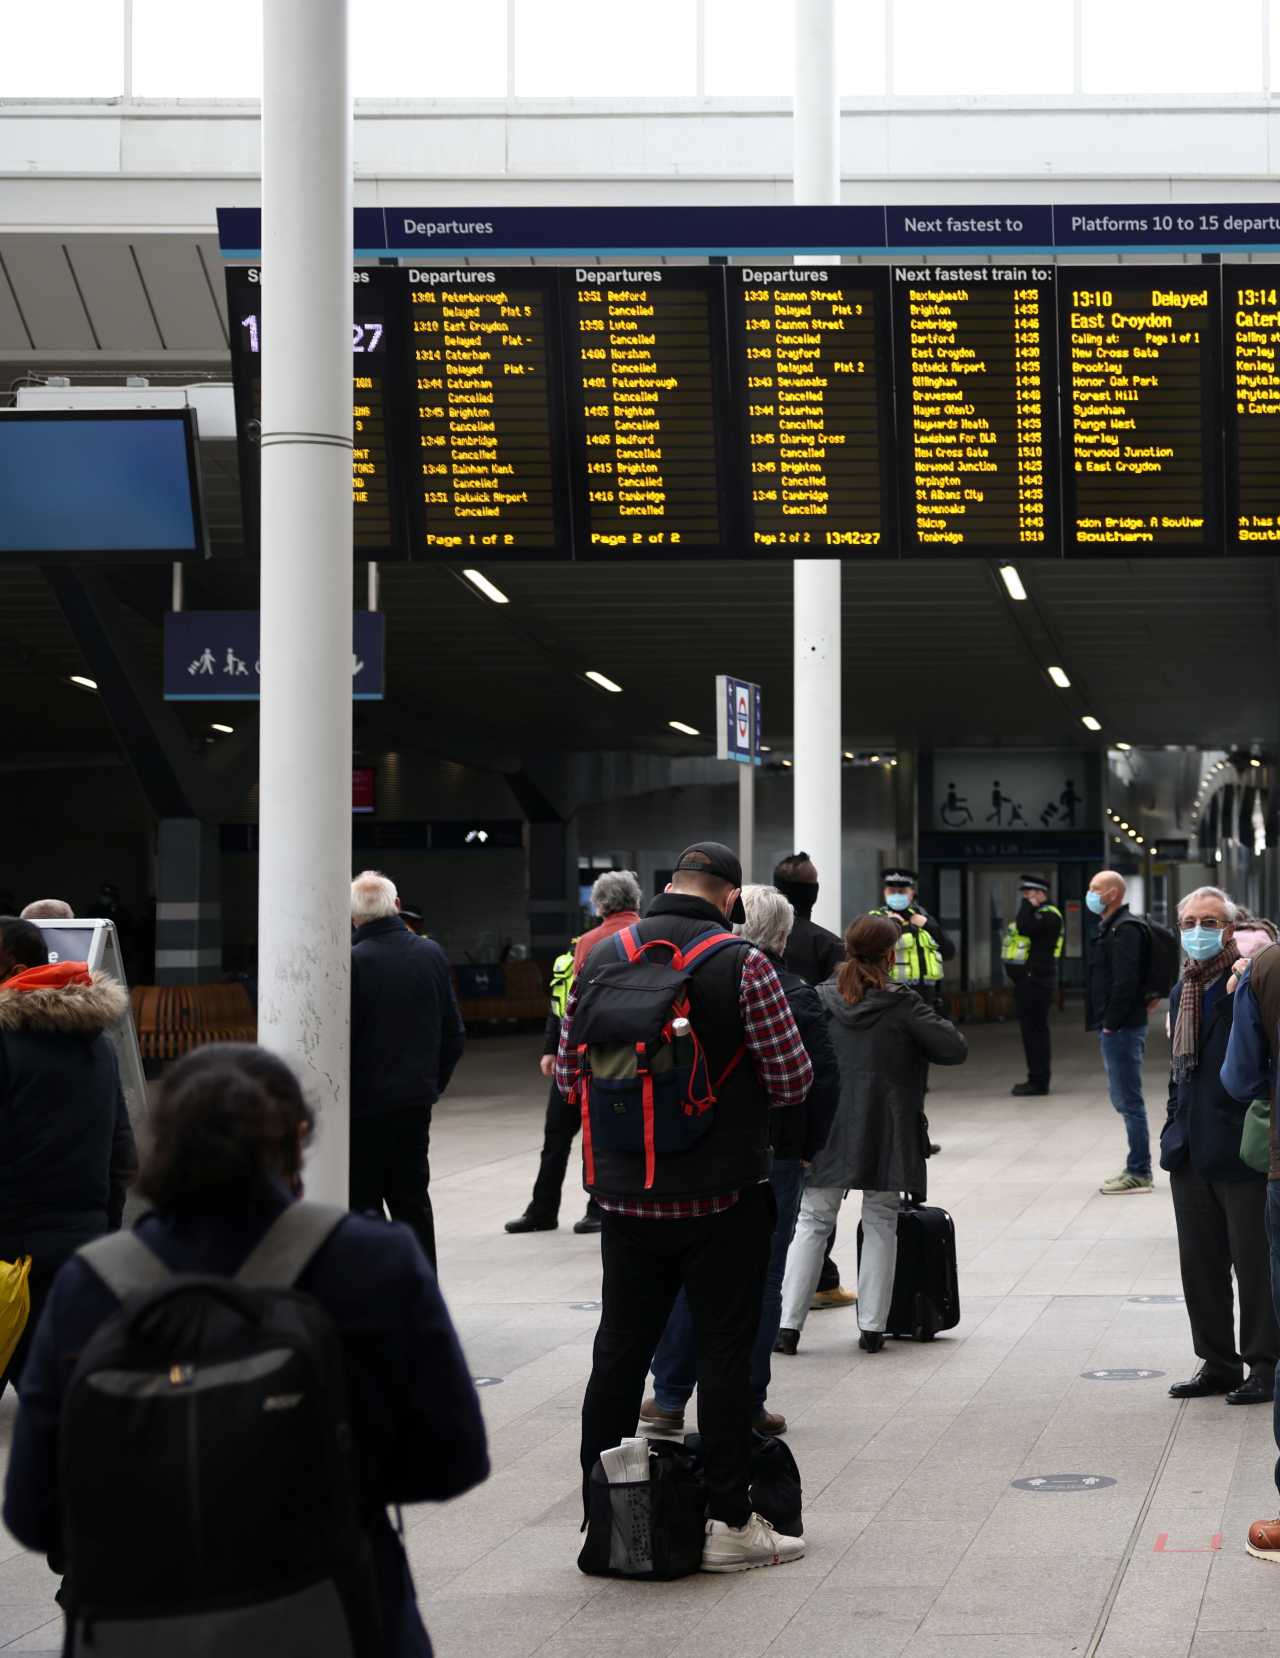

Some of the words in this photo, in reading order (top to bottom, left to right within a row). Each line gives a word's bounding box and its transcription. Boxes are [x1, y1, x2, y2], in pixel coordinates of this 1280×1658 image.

[404, 220, 493, 237] Departures
[905, 218, 942, 232] Next
[947, 217, 1001, 231] fastest
[1006, 219, 1022, 231] to
[1072, 216, 1147, 231] Platforms
[1153, 216, 1172, 230] 10
[1177, 218, 1194, 230] to
[1200, 216, 1218, 230] 15
[409, 270, 495, 285] Departures
[575, 269, 662, 285] Departures
[742, 268, 829, 284] Departures
[895, 268, 931, 281] Next
[935, 267, 988, 280] fastest
[992, 267, 1027, 280] train
[1032, 267, 1053, 280] to:
[1072, 290, 1112, 307] 13:10
[1152, 291, 1208, 308] Delayed
[1238, 289, 1277, 305] 13:14
[1071, 312, 1105, 329] East
[1111, 313, 1172, 330] Croydon
[826, 532, 880, 544] 13:42:27
[1076, 531, 1153, 541] Southern
